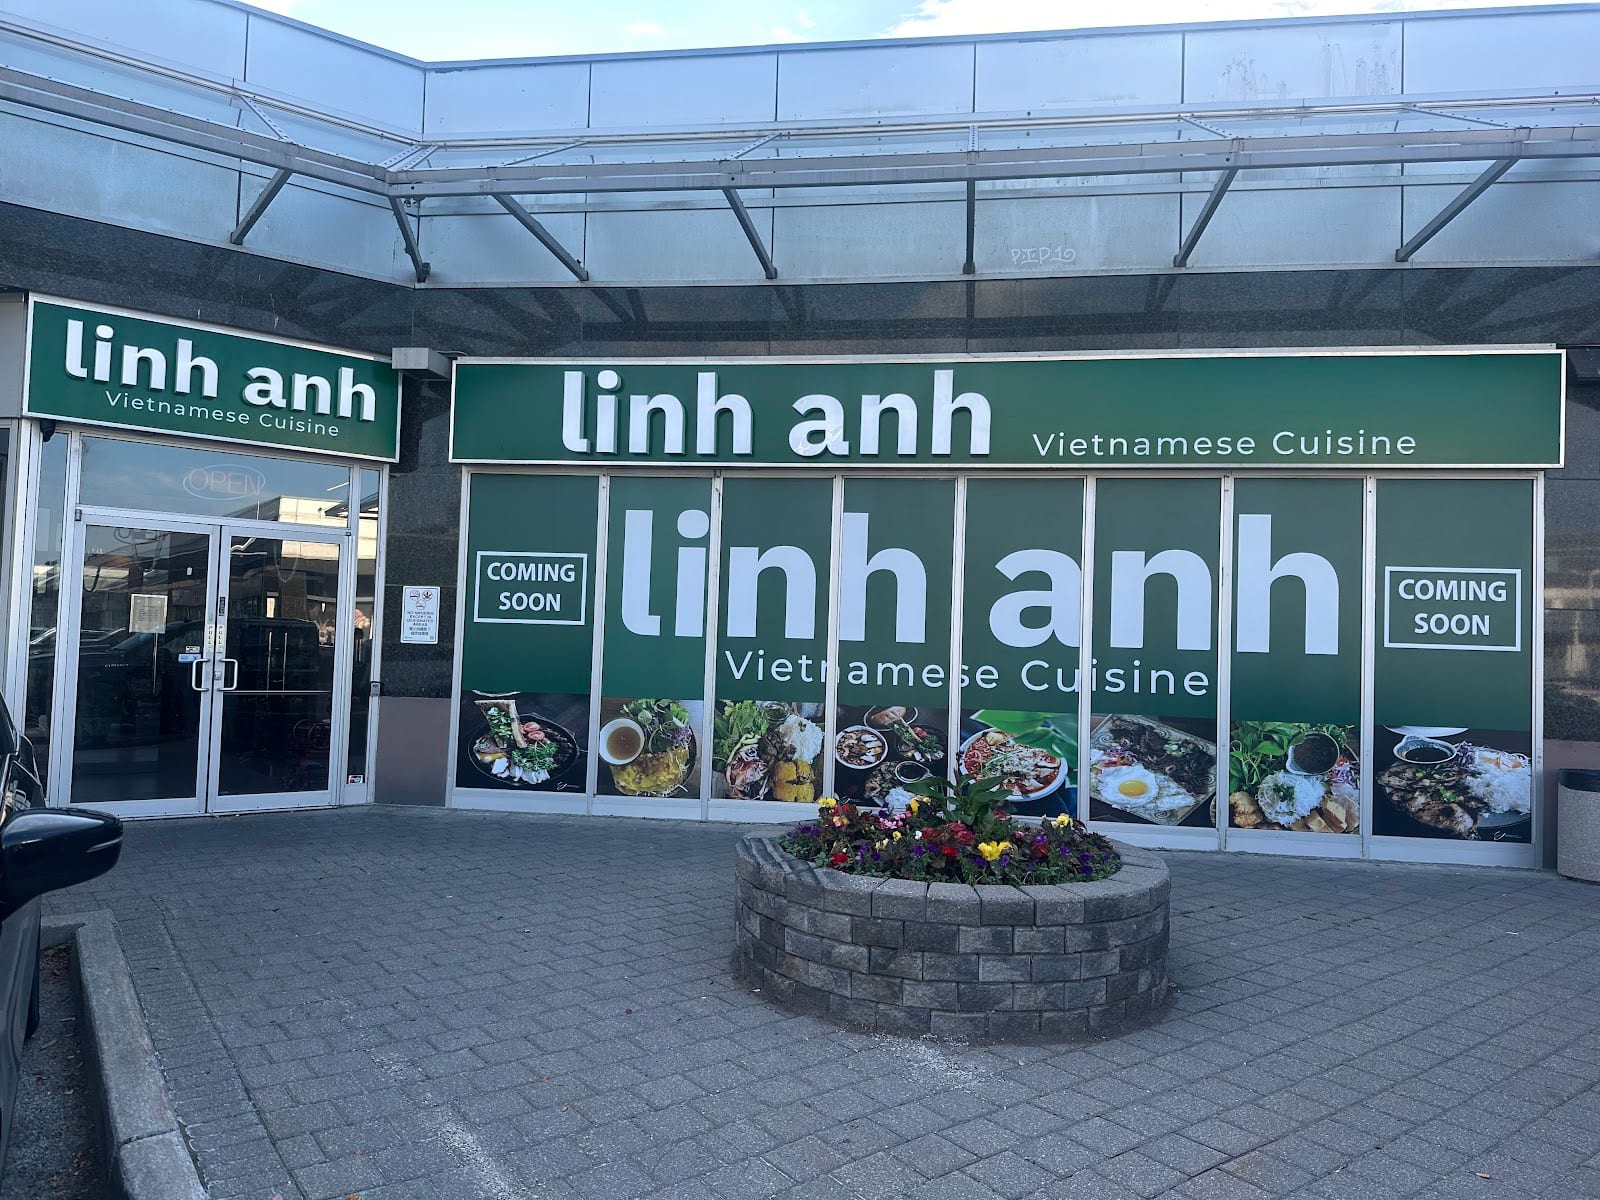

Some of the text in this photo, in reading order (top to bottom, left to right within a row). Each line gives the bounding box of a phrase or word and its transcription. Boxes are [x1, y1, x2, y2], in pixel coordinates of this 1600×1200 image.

[65, 319, 376, 421] linh anh
[105, 391, 340, 438] Vietnamese Cuisine
[561, 369, 992, 457] linh anh
[1032, 429, 1417, 457] Vietnamese Cuisine
[189, 469, 260, 496] OPEN
[487, 561, 576, 583] COMING
[621, 509, 1340, 656] linh anh
[498, 591, 562, 613] SOON
[1398, 578, 1508, 603] COMING
[1413, 612, 1491, 636] SOON
